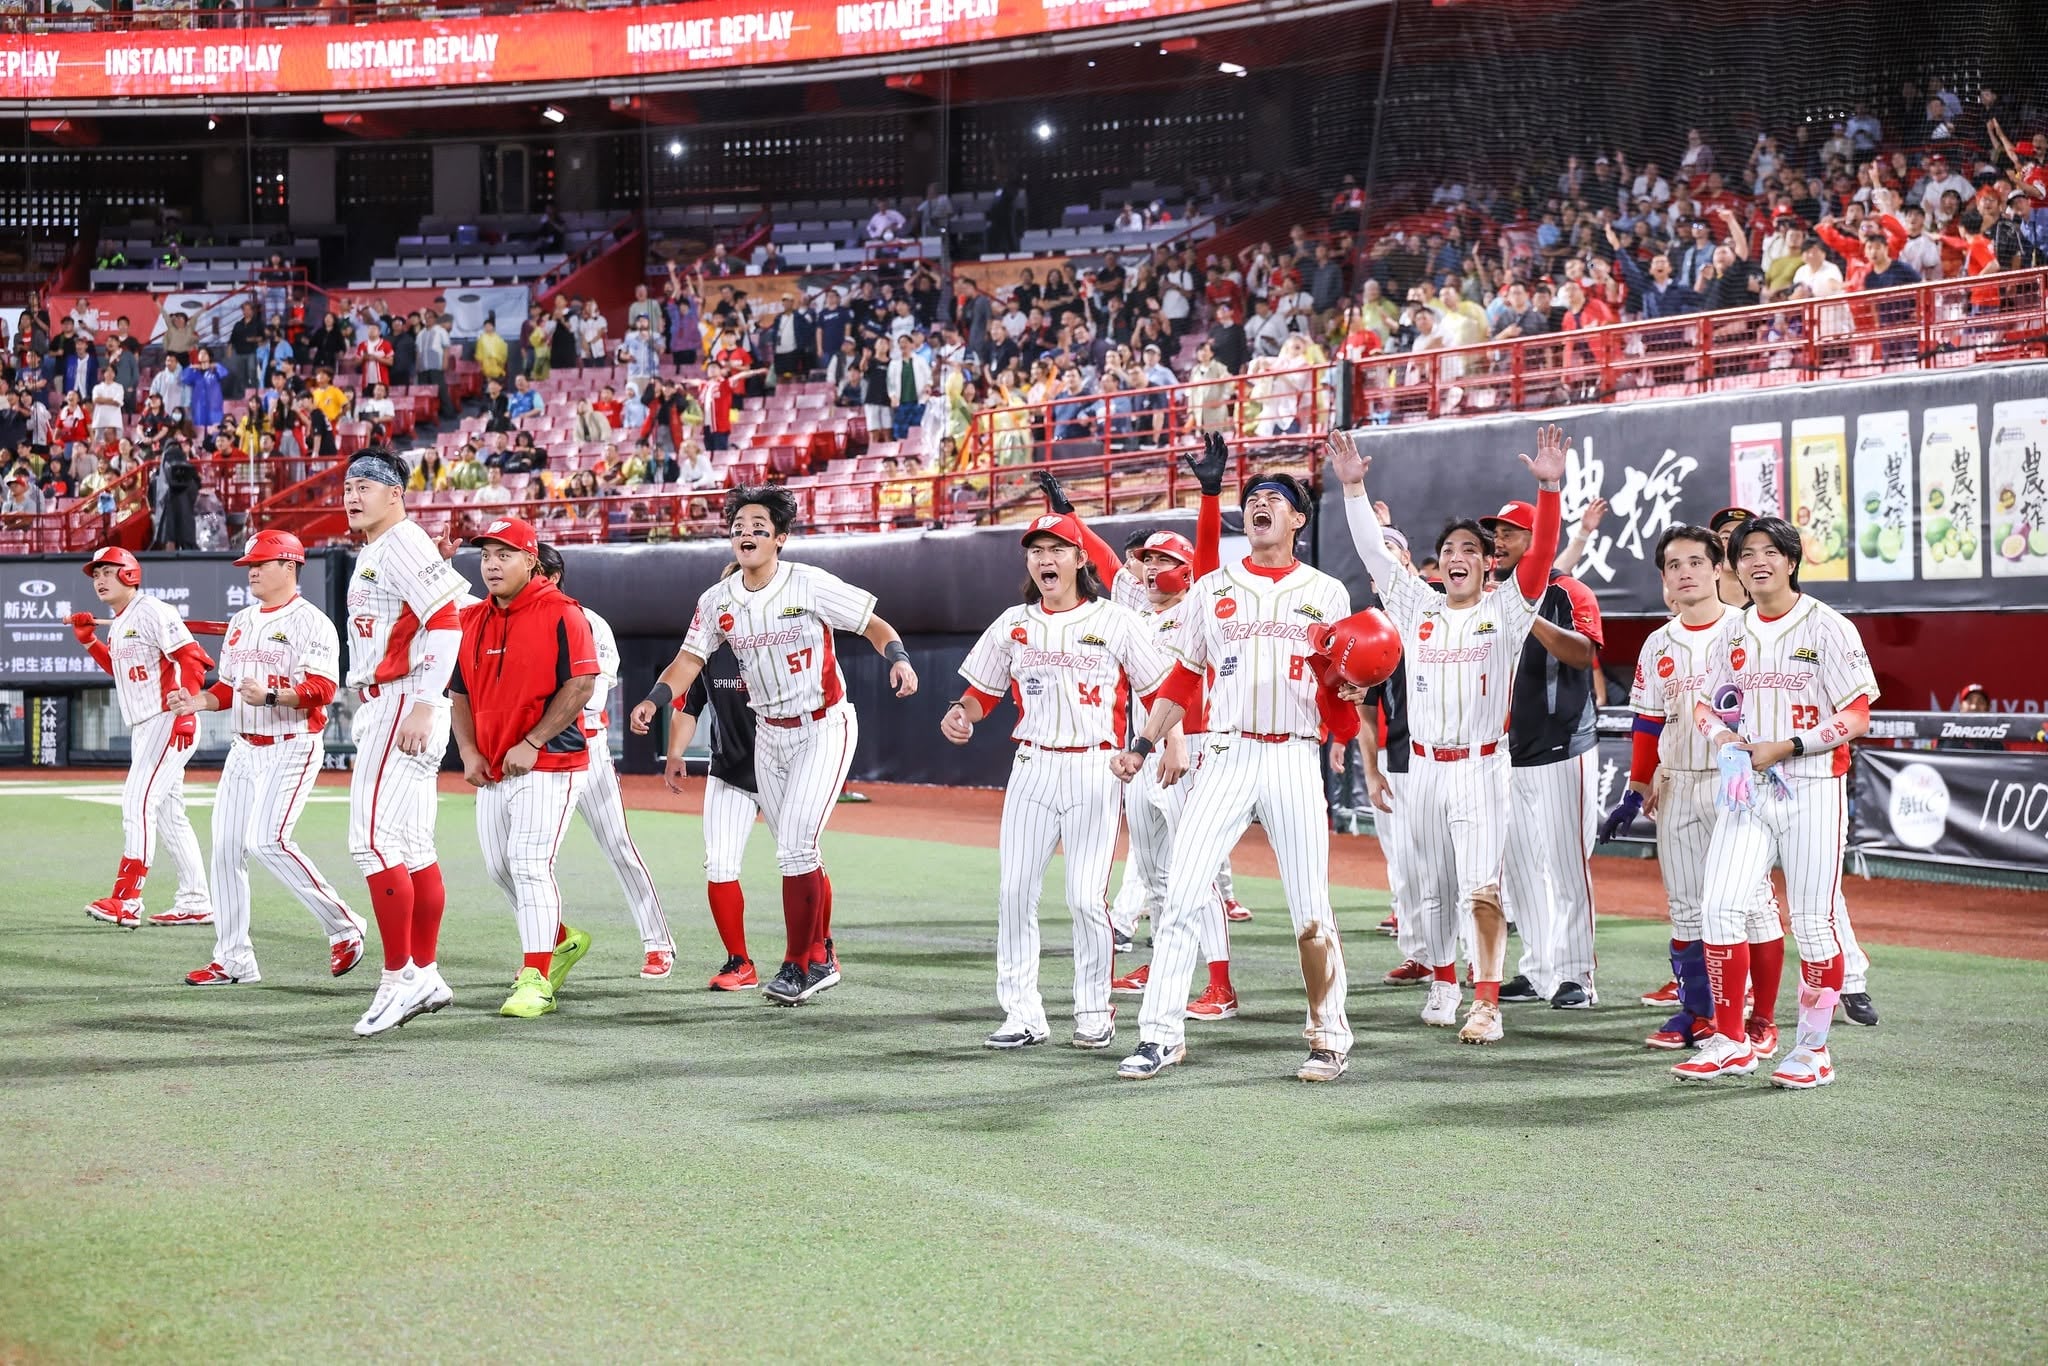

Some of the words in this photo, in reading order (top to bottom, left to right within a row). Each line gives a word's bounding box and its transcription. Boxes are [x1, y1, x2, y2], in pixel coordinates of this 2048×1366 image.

[836, 0, 925, 35] INSTANT
[627, 17, 714, 54] INSTANT
[720, 10, 795, 45] REPLAY
[104, 46, 197, 76] INSTANT
[203, 44, 283, 74] REPLAY
[326, 38, 417, 70] INSTANT
[423, 33, 499, 65] REPLAY
[786, 647, 813, 675] 57
[1289, 654, 1309, 681] 8
[713, 679, 742, 689] SPRING
[1078, 682, 1102, 707] 54
[1480, 673, 1487, 697] 1
[1792, 705, 1819, 730] 23
[1833, 721, 1849, 738] 23
